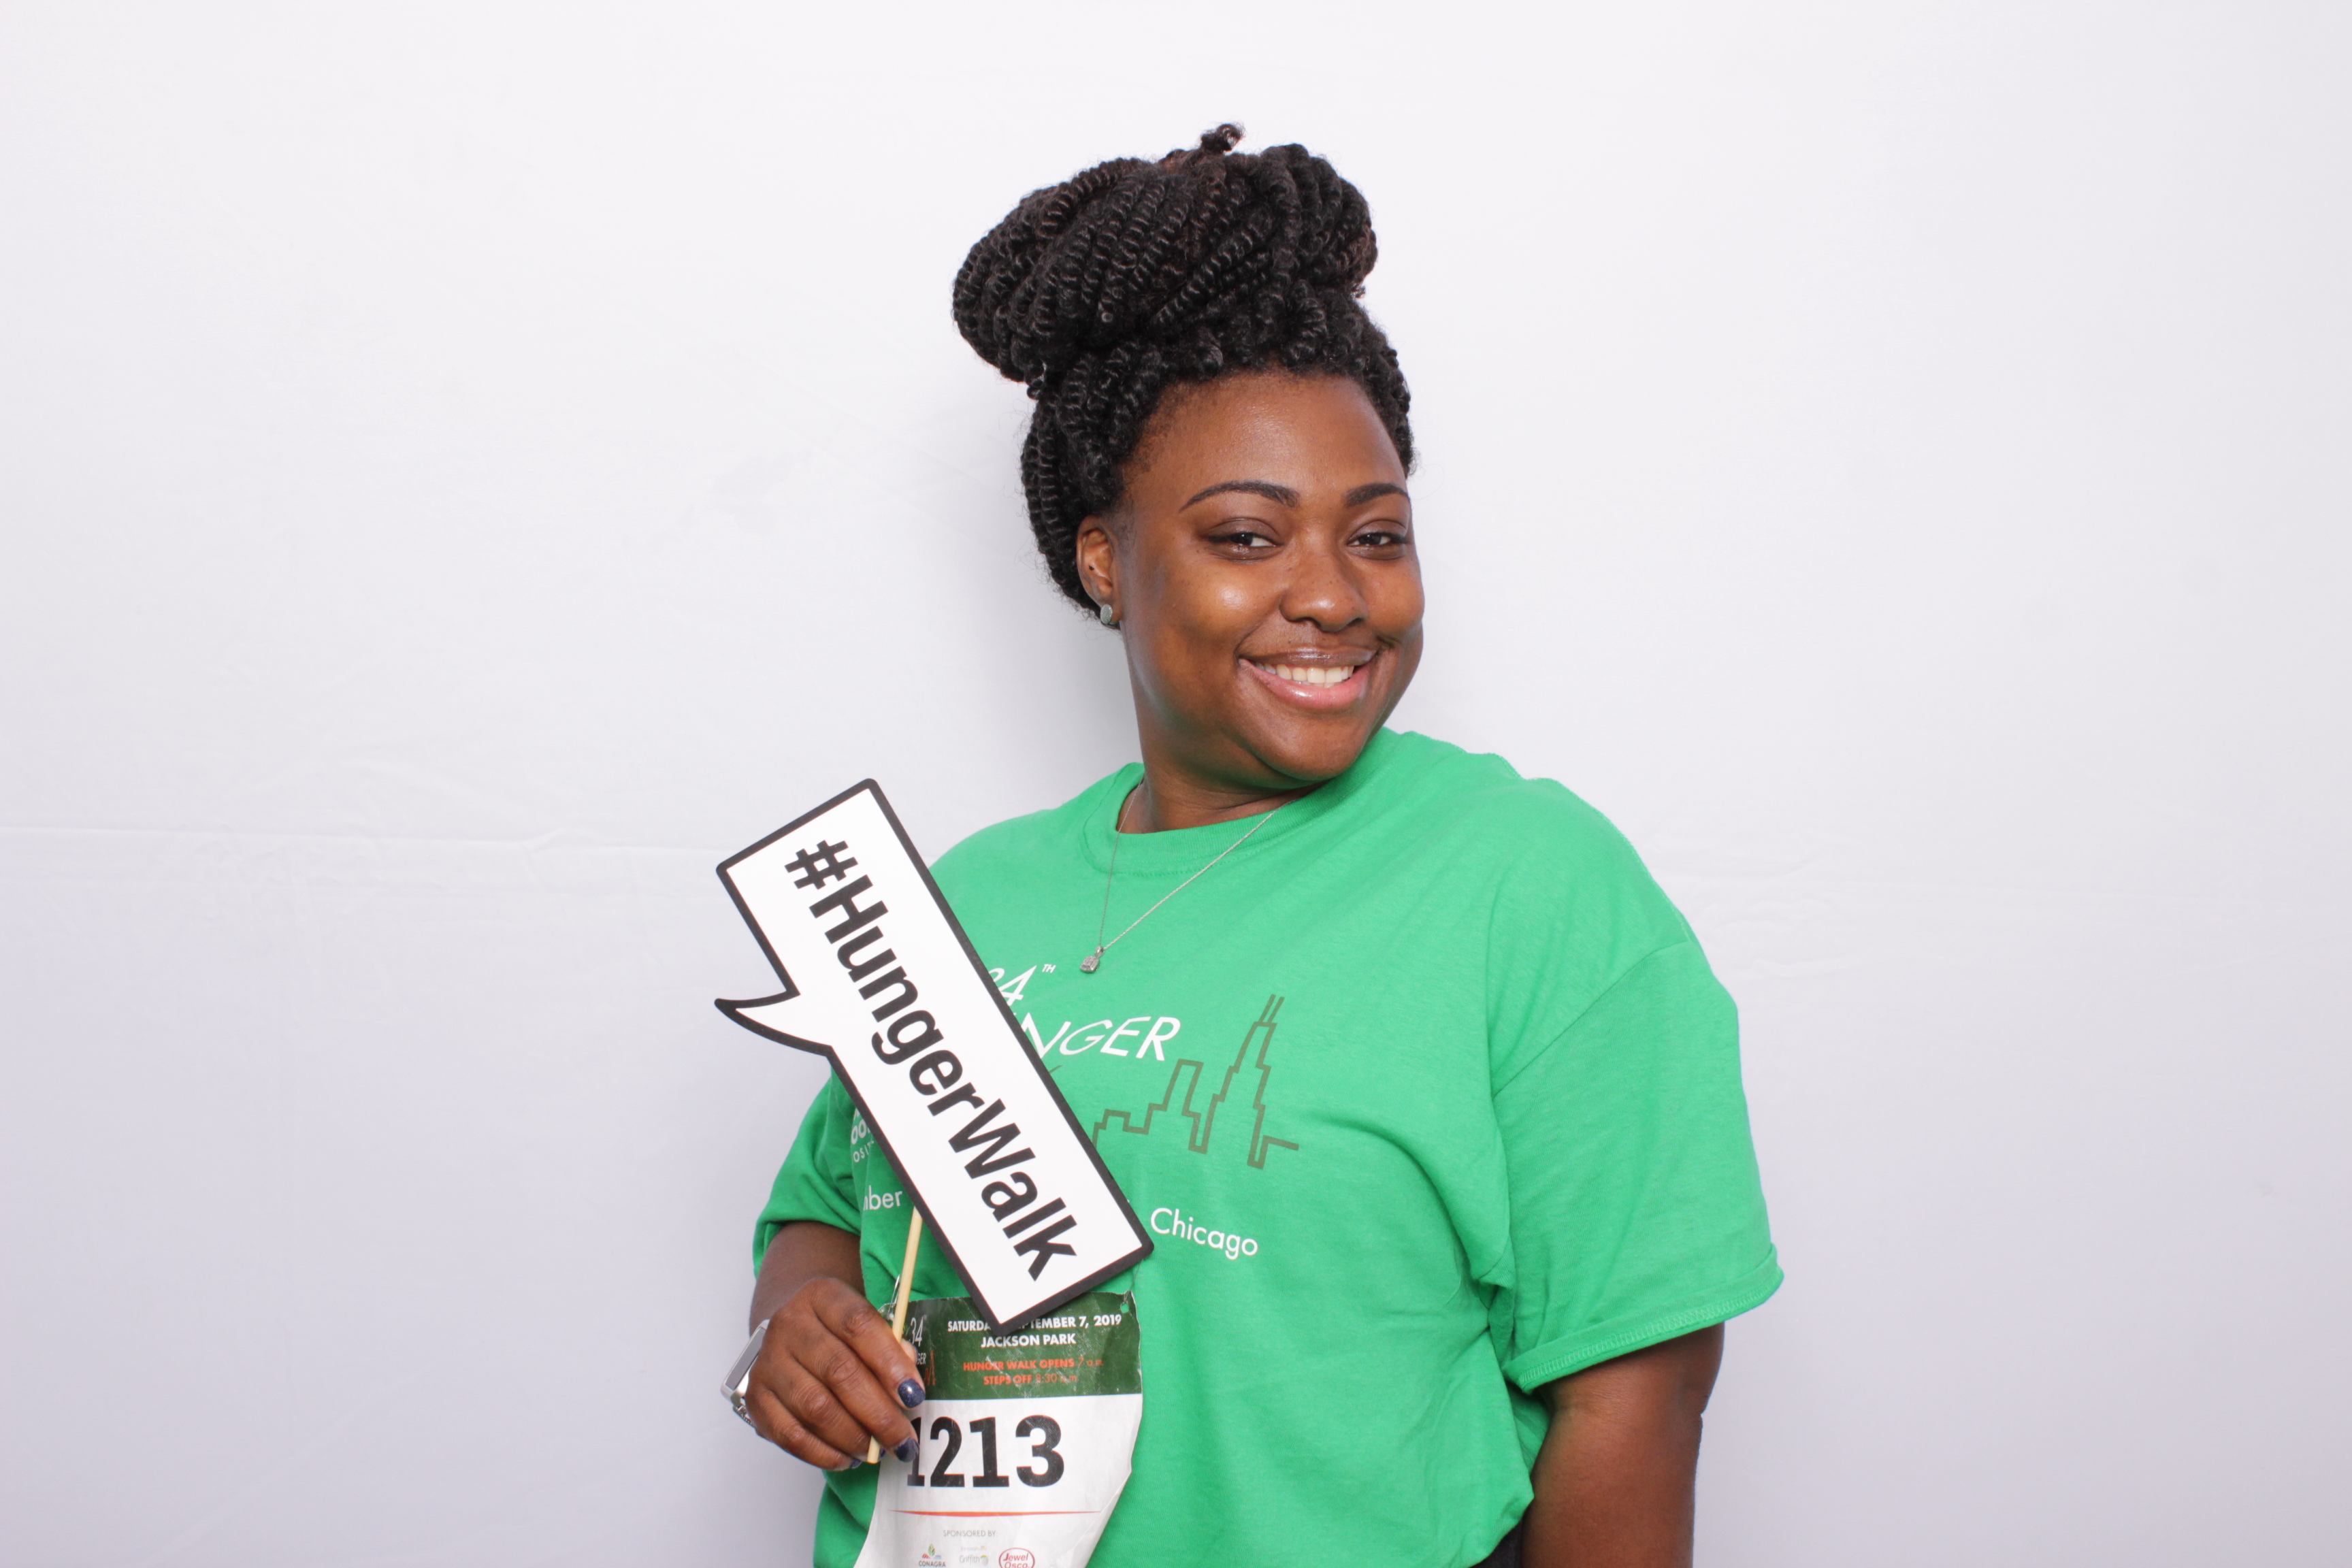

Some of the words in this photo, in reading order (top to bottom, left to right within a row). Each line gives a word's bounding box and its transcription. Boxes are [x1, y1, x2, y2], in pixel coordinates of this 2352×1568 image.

[1013, 1012, 1181, 1061] NGER
[784, 839, 1078, 1281] #HungerWalk
[1150, 1207, 1259, 1260] Chicago
[947, 1320, 992, 1333] SATURDA
[1017, 1316, 1077, 1330] TEMBER
[1079, 1316, 1090, 1329] 7,
[1093, 1314, 1122, 1326] 2019
[981, 1335, 1041, 1348] JACKSON
[1043, 1333, 1077, 1345] PARK
[963, 1360, 1004, 1371] HUNGER
[1006, 1359, 1037, 1370] WALK
[1039, 1358, 1075, 1369] OPENS
[1078, 1357, 1085, 1367] 7
[983, 1375, 1012, 1385] STEPS
[1013, 1375, 1033, 1384] OFF
[907, 1414, 1065, 1488] 1213
[943, 1529, 986, 1537] SPONSORED
[918, 1560, 947, 1568] CONAGRA
[1002, 1552, 1029, 1561] Jewel
